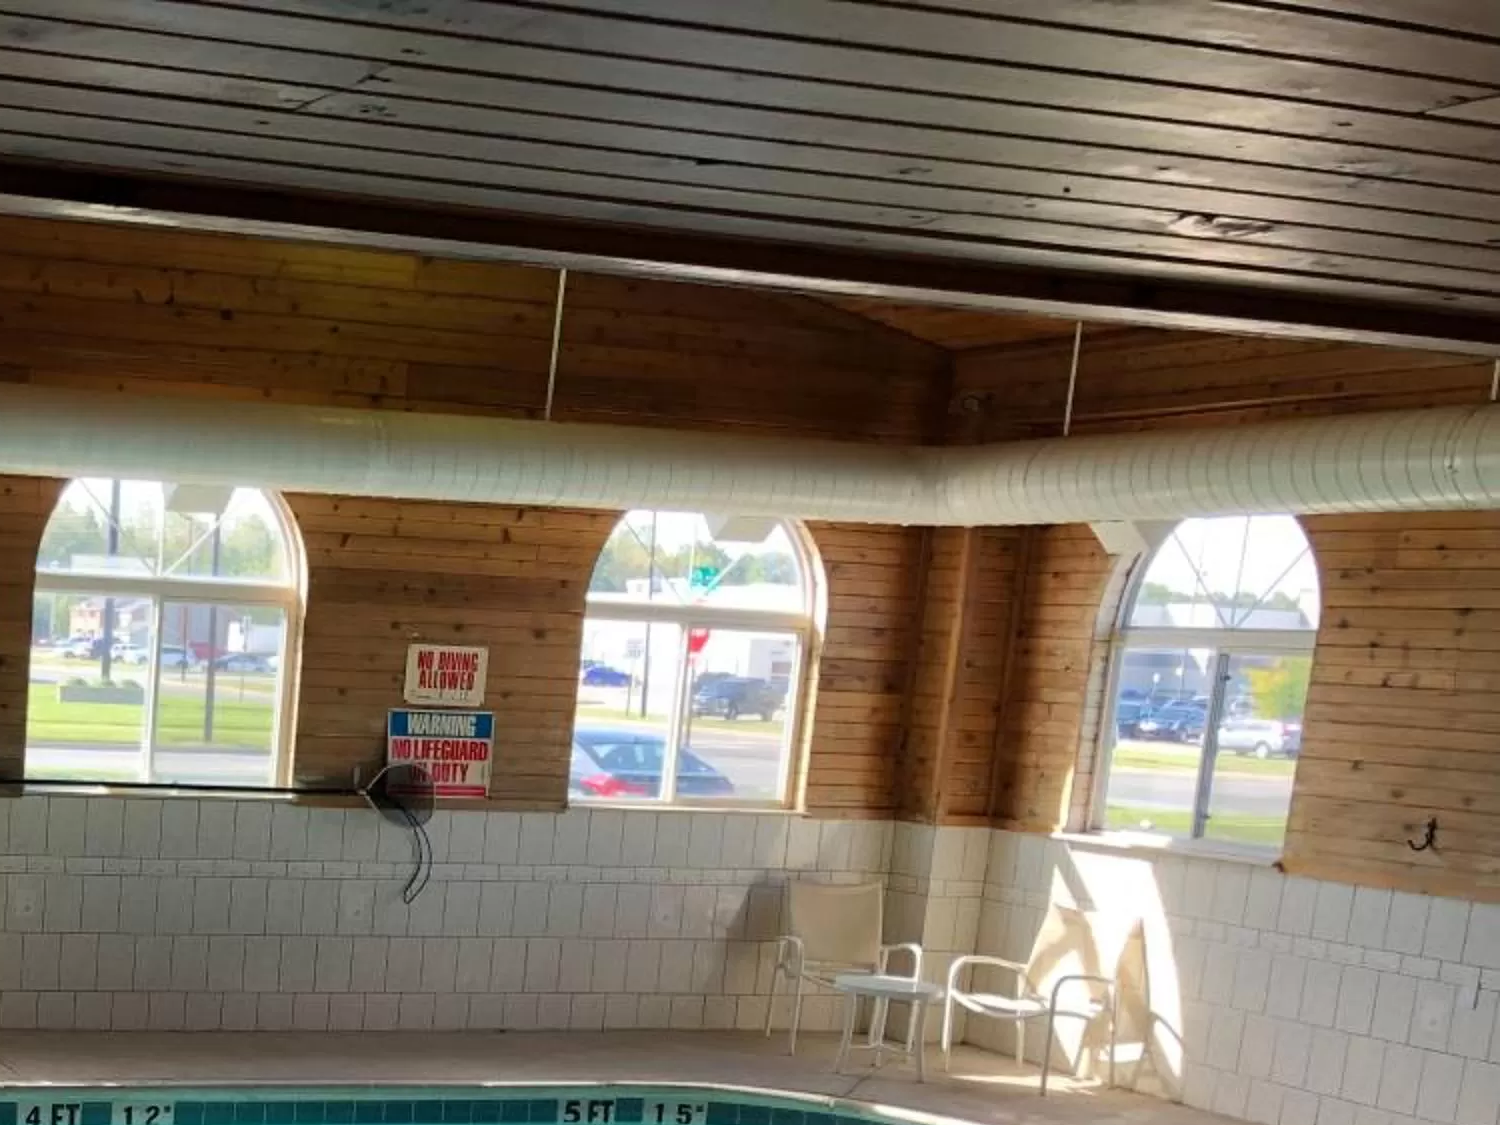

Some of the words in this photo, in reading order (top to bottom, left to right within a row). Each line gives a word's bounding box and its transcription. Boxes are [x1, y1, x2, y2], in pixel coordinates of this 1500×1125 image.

[418, 651, 434, 669] NO
[438, 652, 478, 673] DIVING
[419, 670, 474, 690] ALLOWED
[409, 713, 477, 737] WARNING
[392, 739, 411, 759] NO
[414, 740, 488, 761] LIFEGUARD
[432, 762, 469, 783] DUTY
[563, 1100, 581, 1123] 5
[587, 1100, 615, 1124] FT
